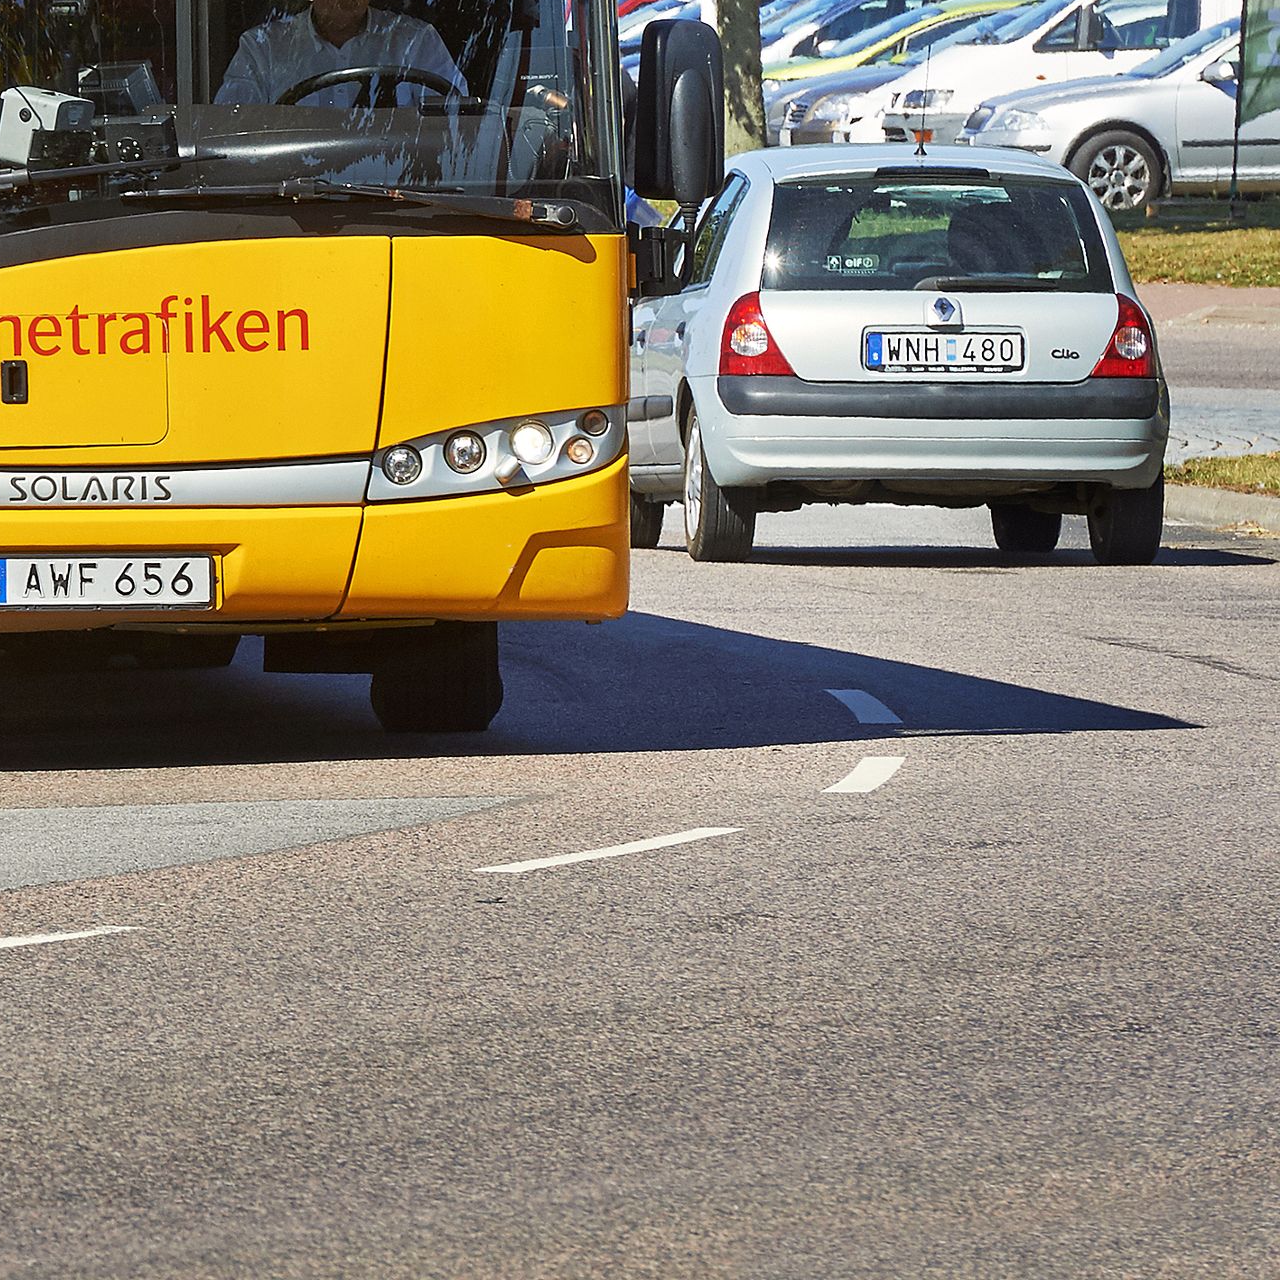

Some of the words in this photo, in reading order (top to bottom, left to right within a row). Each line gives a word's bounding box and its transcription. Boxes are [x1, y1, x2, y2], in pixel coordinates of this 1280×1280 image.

[887, 337, 940, 362] WNH
[962, 338, 1014, 362] 480
[8, 475, 173, 502] SOLARIS
[22, 562, 98, 598] AWF
[114, 562, 194, 597] 656
